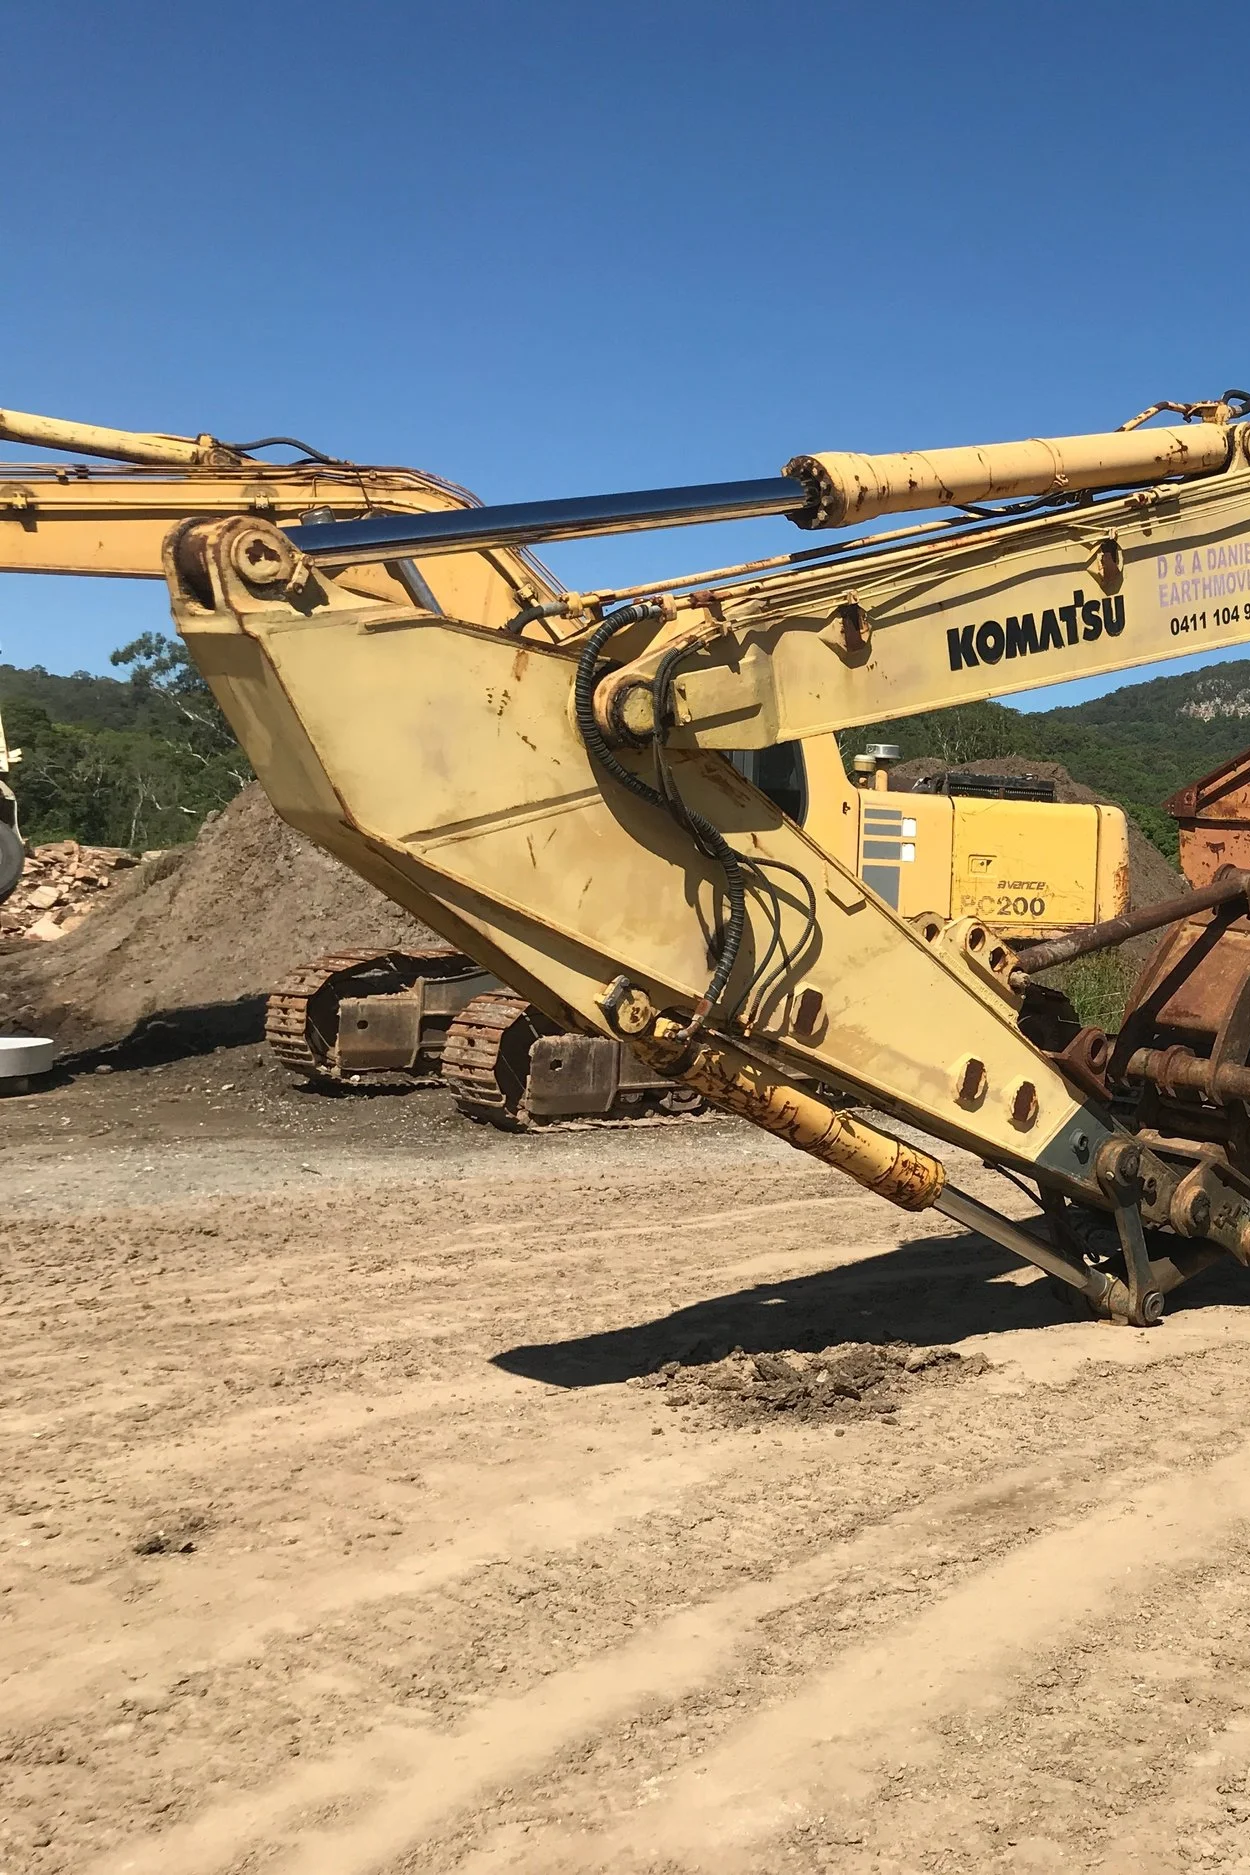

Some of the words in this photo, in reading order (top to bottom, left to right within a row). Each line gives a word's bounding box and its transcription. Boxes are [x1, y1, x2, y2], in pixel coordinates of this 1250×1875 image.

[1157, 555, 1168, 579] D
[1175, 553, 1185, 576] &
[1192, 550, 1203, 574] A
[946, 589, 1126, 671] KOMATSU
[1170, 612, 1207, 636] 0411
[1213, 605, 1240, 626] 104
